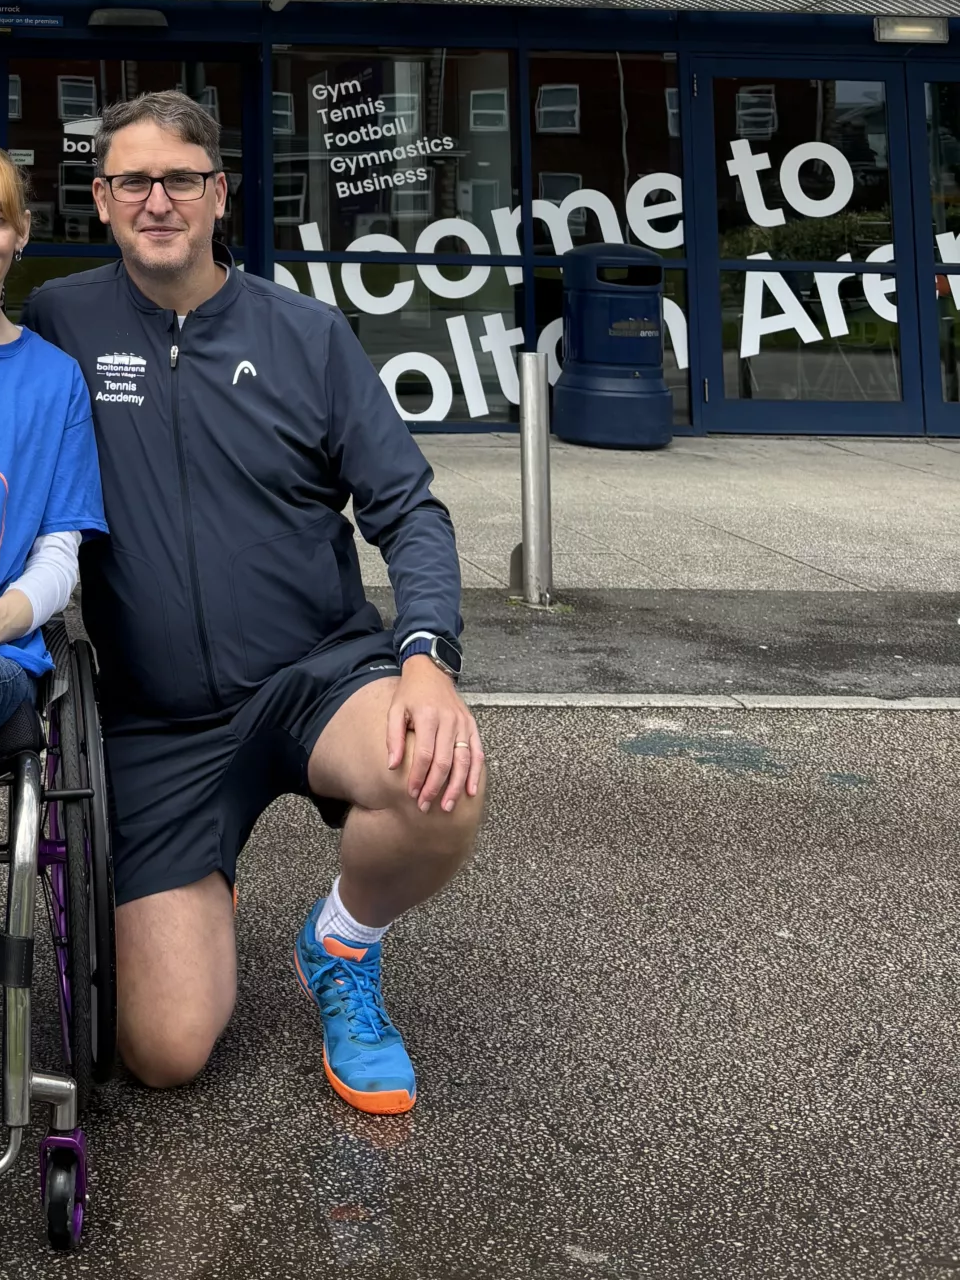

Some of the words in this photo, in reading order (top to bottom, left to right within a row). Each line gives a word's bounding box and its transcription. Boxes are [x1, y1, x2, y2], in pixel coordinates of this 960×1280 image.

[312, 79, 362, 103] Gym
[317, 98, 386, 125] Tennis
[323, 117, 408, 150] Football
[329, 135, 454, 176] Gymnastics
[335, 166, 428, 199] Business
[726, 138, 854, 228] to
[96, 363, 146, 373] boltonarena
[95, 391, 145, 406] Academy
[104, 380, 137, 391] Tennis
